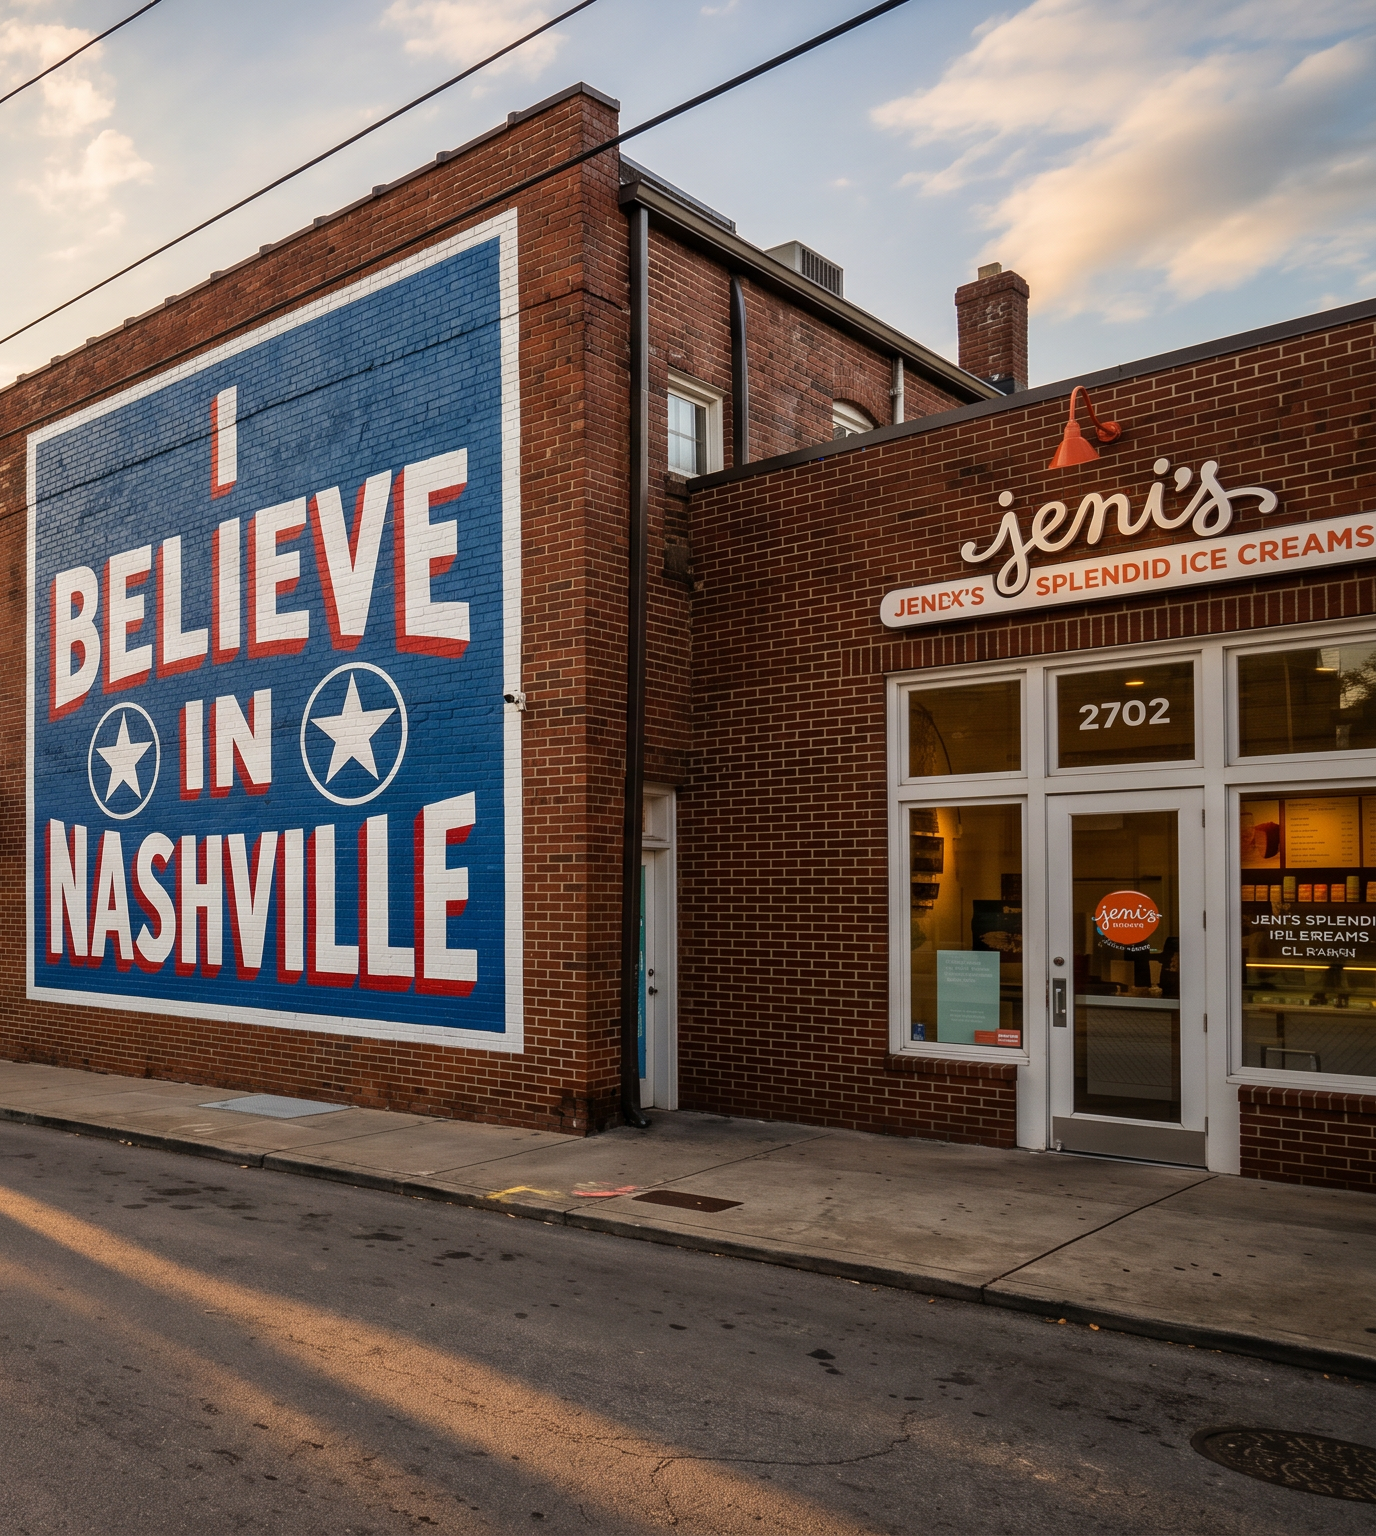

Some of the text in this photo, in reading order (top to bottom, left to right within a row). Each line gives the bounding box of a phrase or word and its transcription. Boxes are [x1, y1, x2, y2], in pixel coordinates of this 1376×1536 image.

[211, 385, 238, 499] I
[960, 457, 1279, 595] jeni's
[1035, 557, 1171, 597] SPLENDID
[1180, 547, 1227, 574] ICE
[1236, 525, 1375, 566] CREAMS
[49, 447, 471, 722] BELIEVE
[179, 688, 272, 801] IN
[1079, 697, 1171, 731] 2702
[46, 791, 478, 997] NASHVILLE
